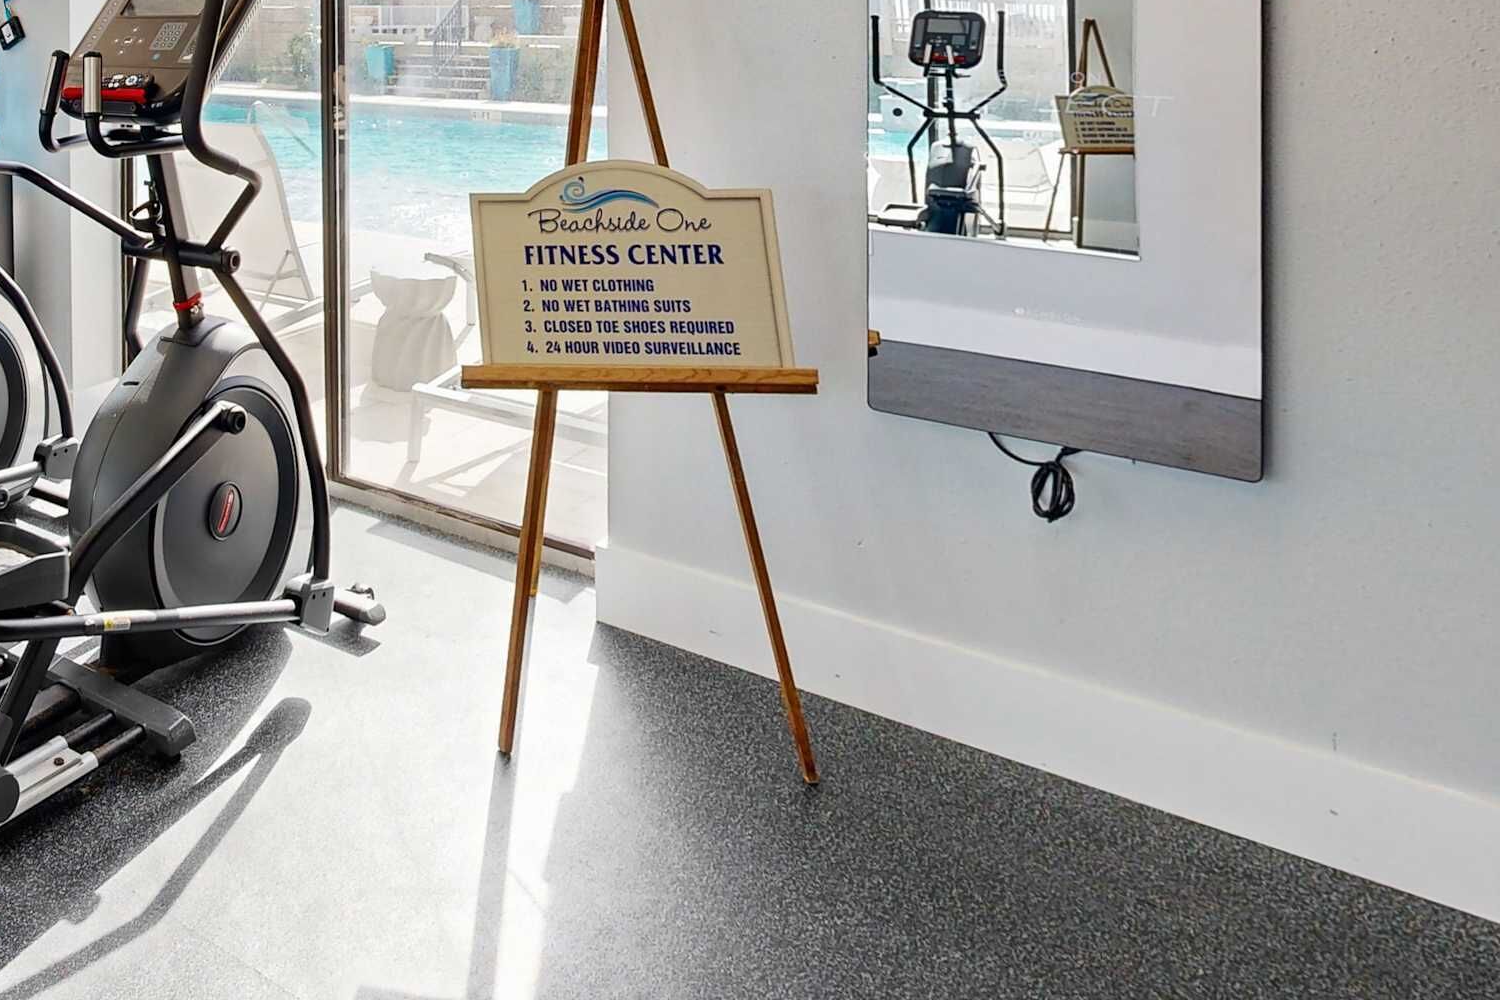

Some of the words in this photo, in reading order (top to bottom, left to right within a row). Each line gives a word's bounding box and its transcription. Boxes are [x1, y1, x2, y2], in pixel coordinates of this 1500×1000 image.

[527, 207, 651, 234] Beachside
[656, 207, 712, 233] One
[524, 244, 620, 266] FITNESS
[627, 243, 725, 266] CENTER
[521, 279, 533, 293] 1.
[539, 279, 558, 293] NO
[561, 278, 589, 293] WET
[592, 278, 655, 293] CLOTHING
[522, 299, 535, 313] 2.
[541, 299, 560, 313] NO
[563, 299, 591, 313] WET
[594, 299, 650, 313] BATHING
[653, 299, 692, 314] SUITS
[524, 319, 537, 334] 3.
[543, 319, 593, 334] CLOSED
[595, 319, 621, 334] TOE
[623, 320, 667, 334] SHOES
[669, 320, 735, 336] REQUIRED
[526, 340, 539, 354] 4.
[545, 340, 562, 354] 24
[564, 340, 600, 355] HOUR
[603, 340, 641, 355] VIDEO
[643, 341, 742, 356] SURVEILLANCE
